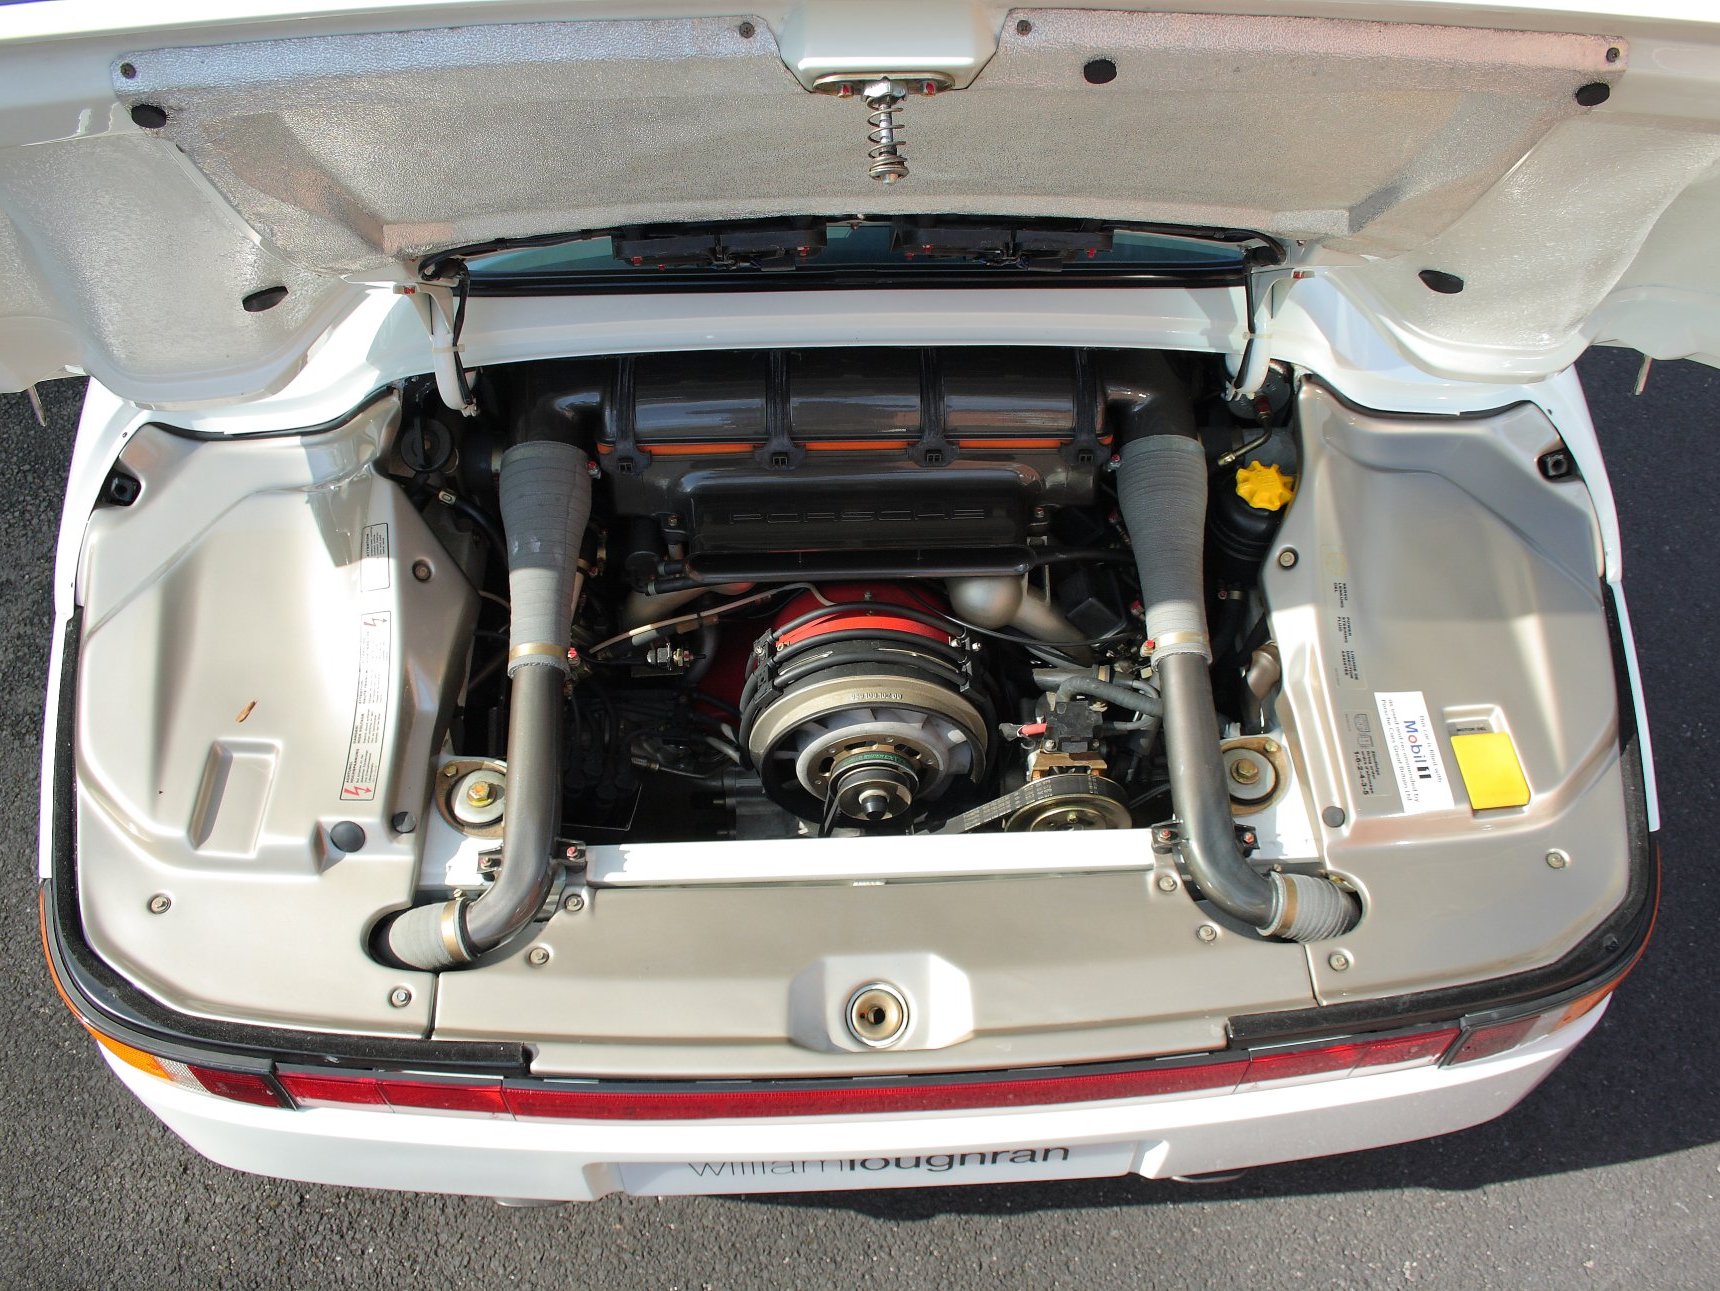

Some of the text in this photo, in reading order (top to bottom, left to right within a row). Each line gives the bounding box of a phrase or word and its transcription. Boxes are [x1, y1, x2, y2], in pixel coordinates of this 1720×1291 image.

[730, 509, 985, 524] PORSCHE
[1381, 699, 1392, 726] Porsche
[1392, 745, 1401, 764] Great
[1403, 720, 1428, 763] Mobil
